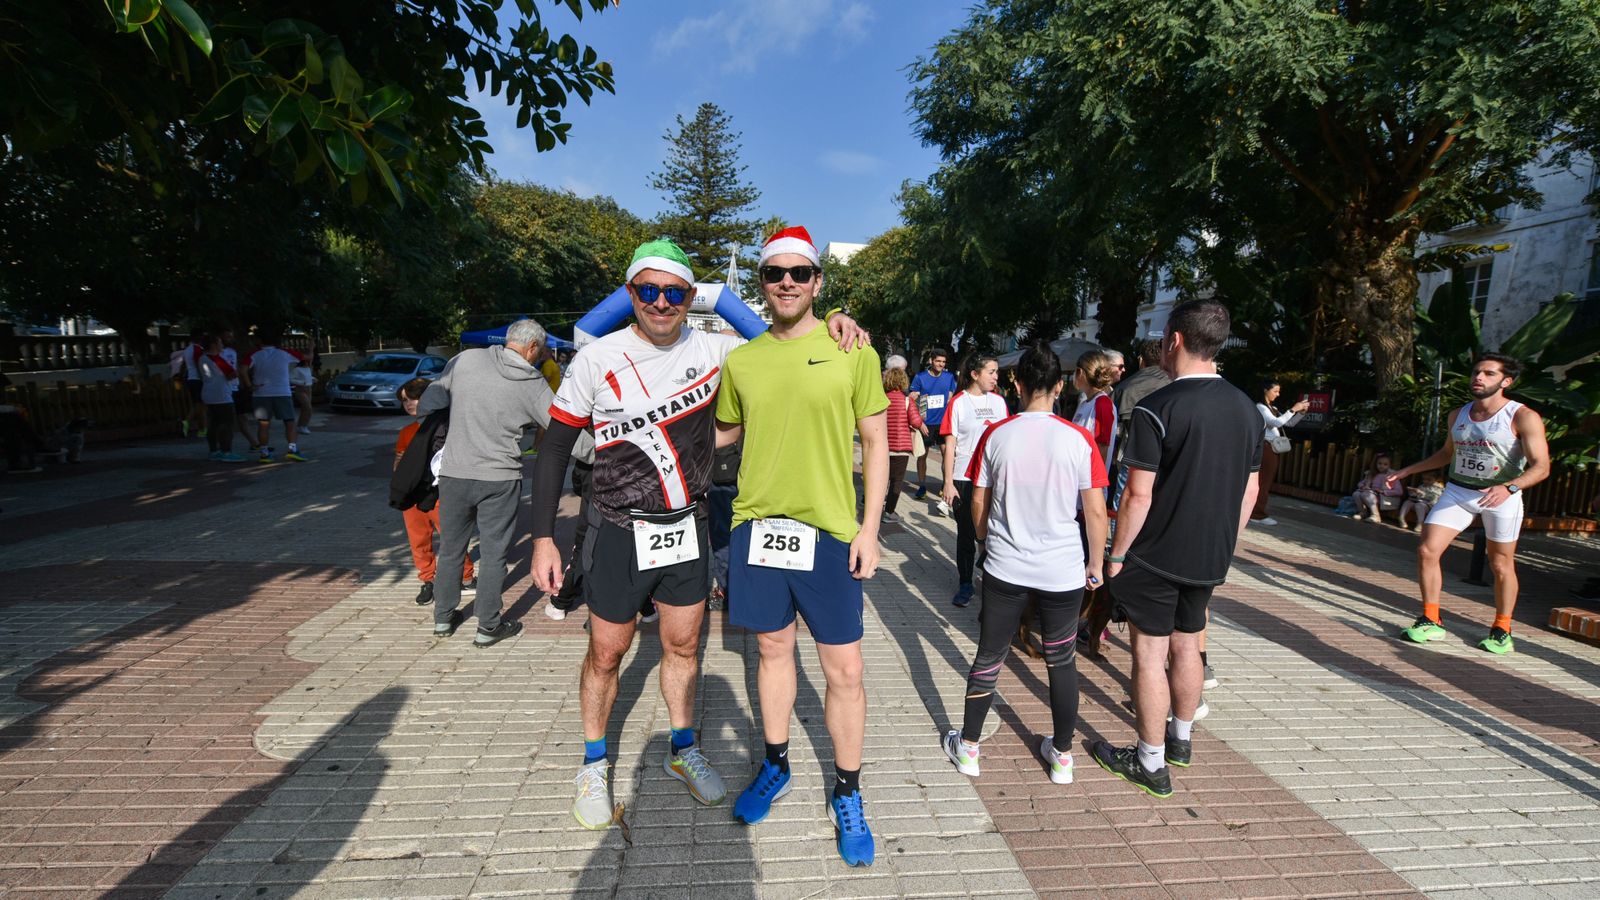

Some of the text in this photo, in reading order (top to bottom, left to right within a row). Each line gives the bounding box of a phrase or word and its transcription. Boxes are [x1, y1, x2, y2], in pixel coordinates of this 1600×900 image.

[601, 383, 712, 442] TURDETANIA
[646, 430, 674, 476] TEAM
[1461, 458, 1485, 472] 156
[649, 530, 685, 551] 257
[762, 533, 801, 553] 258
